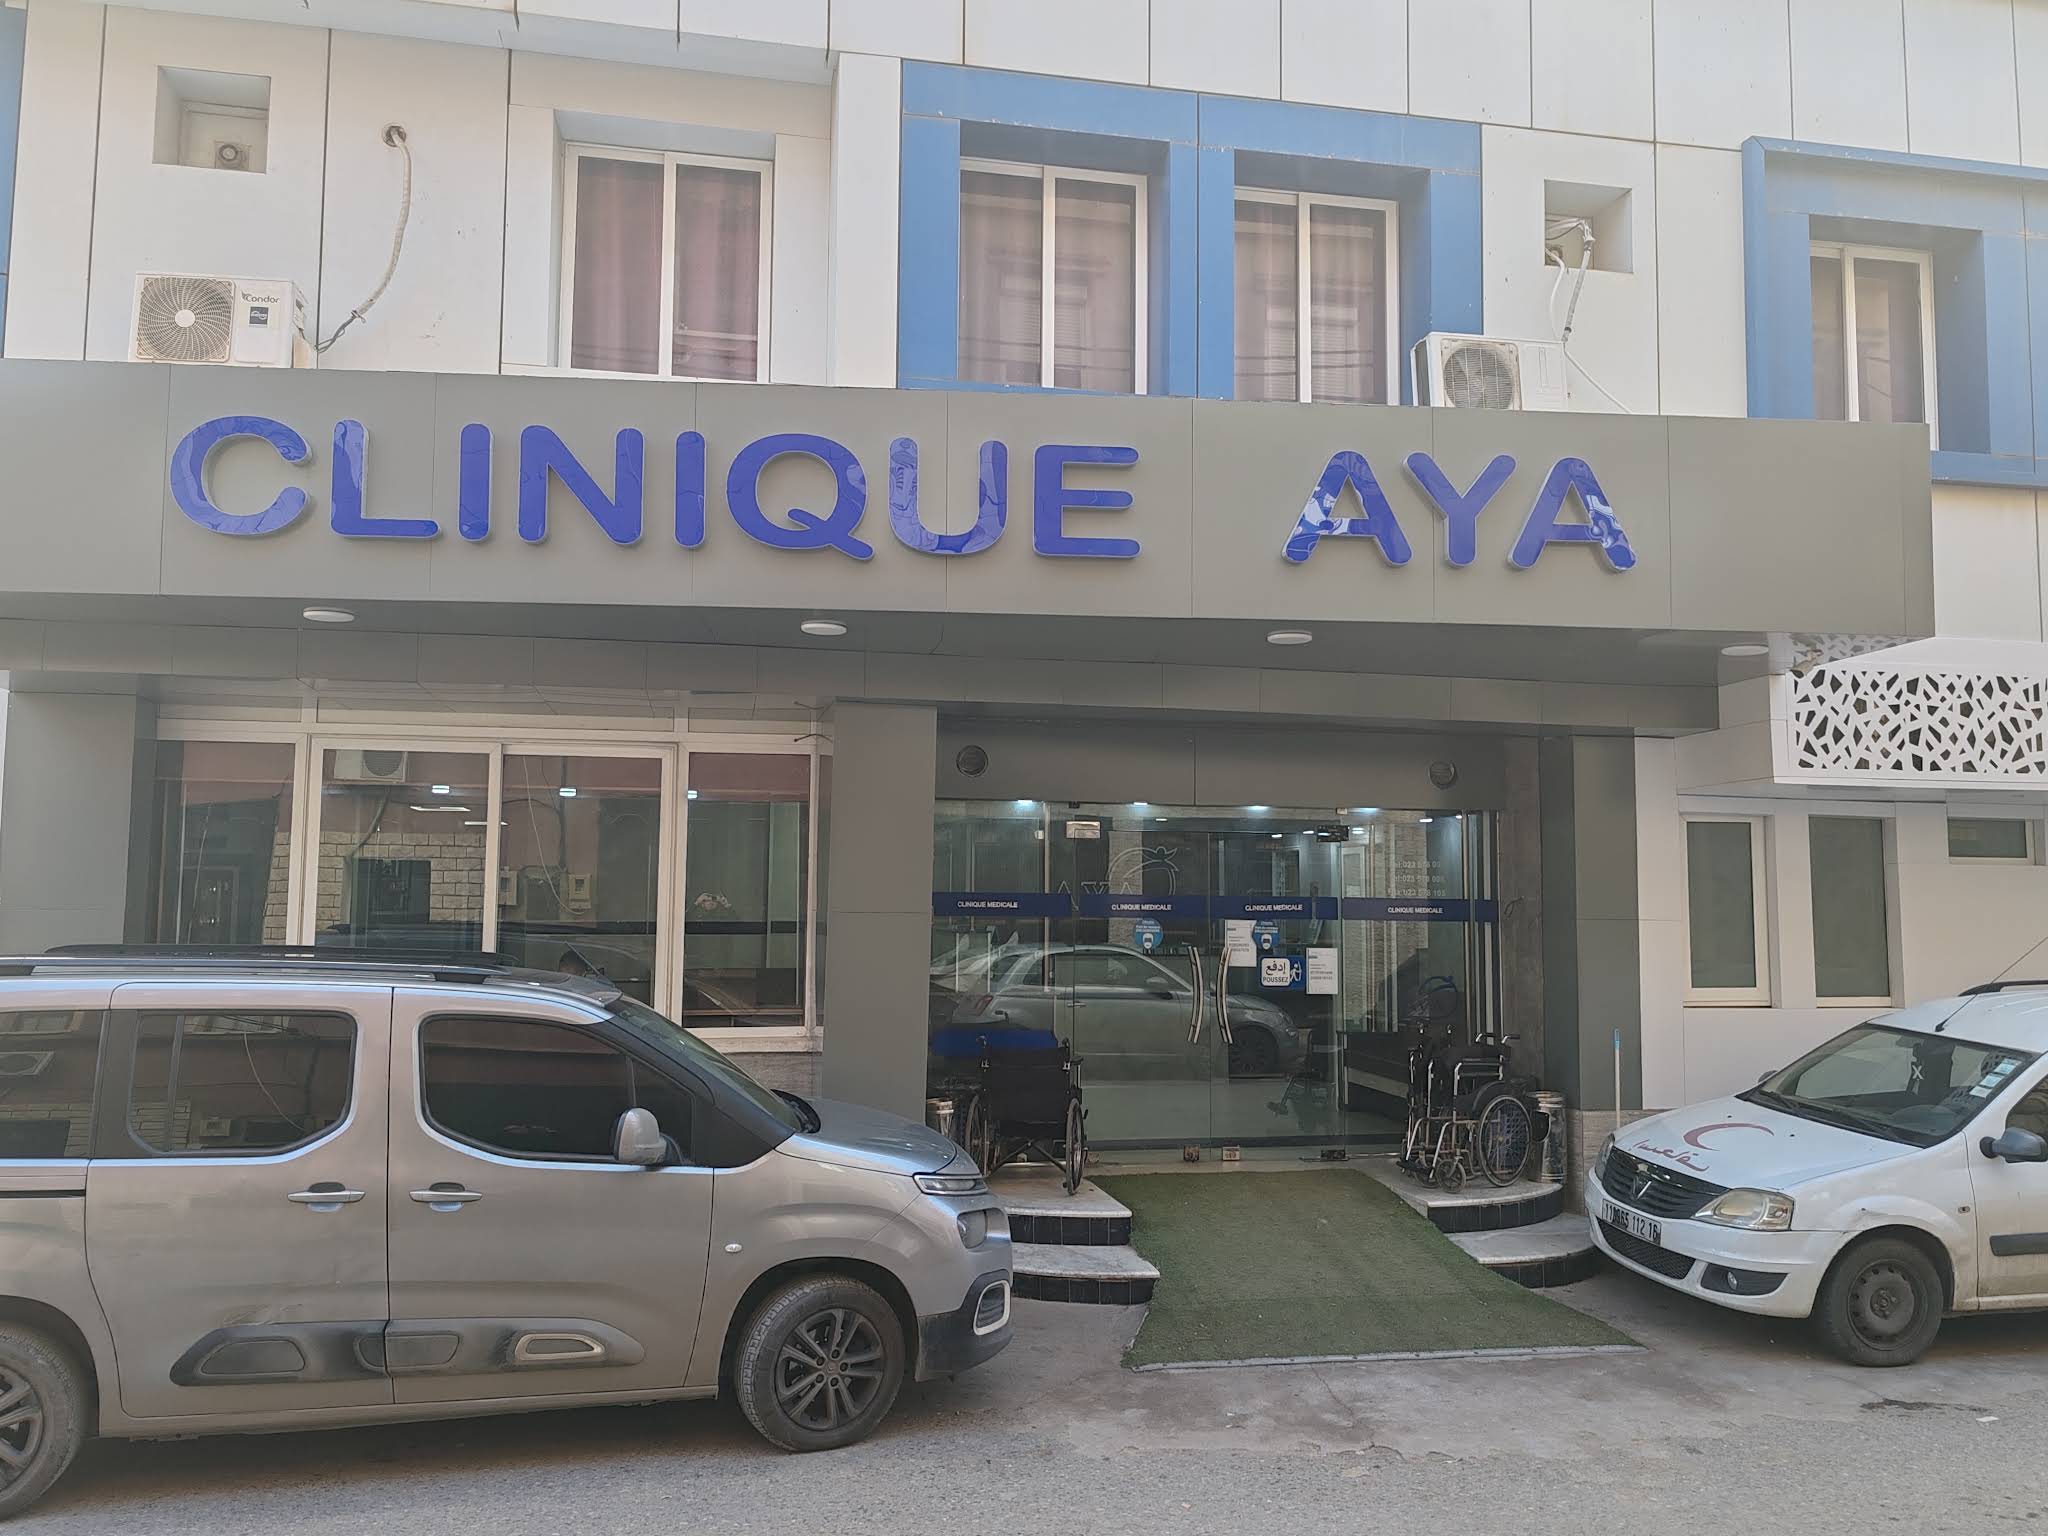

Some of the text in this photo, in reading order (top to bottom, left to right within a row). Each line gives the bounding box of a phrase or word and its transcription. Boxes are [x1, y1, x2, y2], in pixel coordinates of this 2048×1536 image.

[245, 293, 280, 303] Condor
[171, 415, 1636, 572] CLINIQUE AYA
[957, 900, 1018, 909] CLINIQUE MEDICALE
[1111, 903, 1172, 911] CLINIQUE MEDICALE
[1244, 904, 1272, 912] CLINIQUE
[1387, 906, 1414, 914] CLINIQUE
[1265, 960, 1286, 975] إدفع
[1632, 1215, 1645, 1236] 112
[1648, 1222, 1658, 1240] 16
